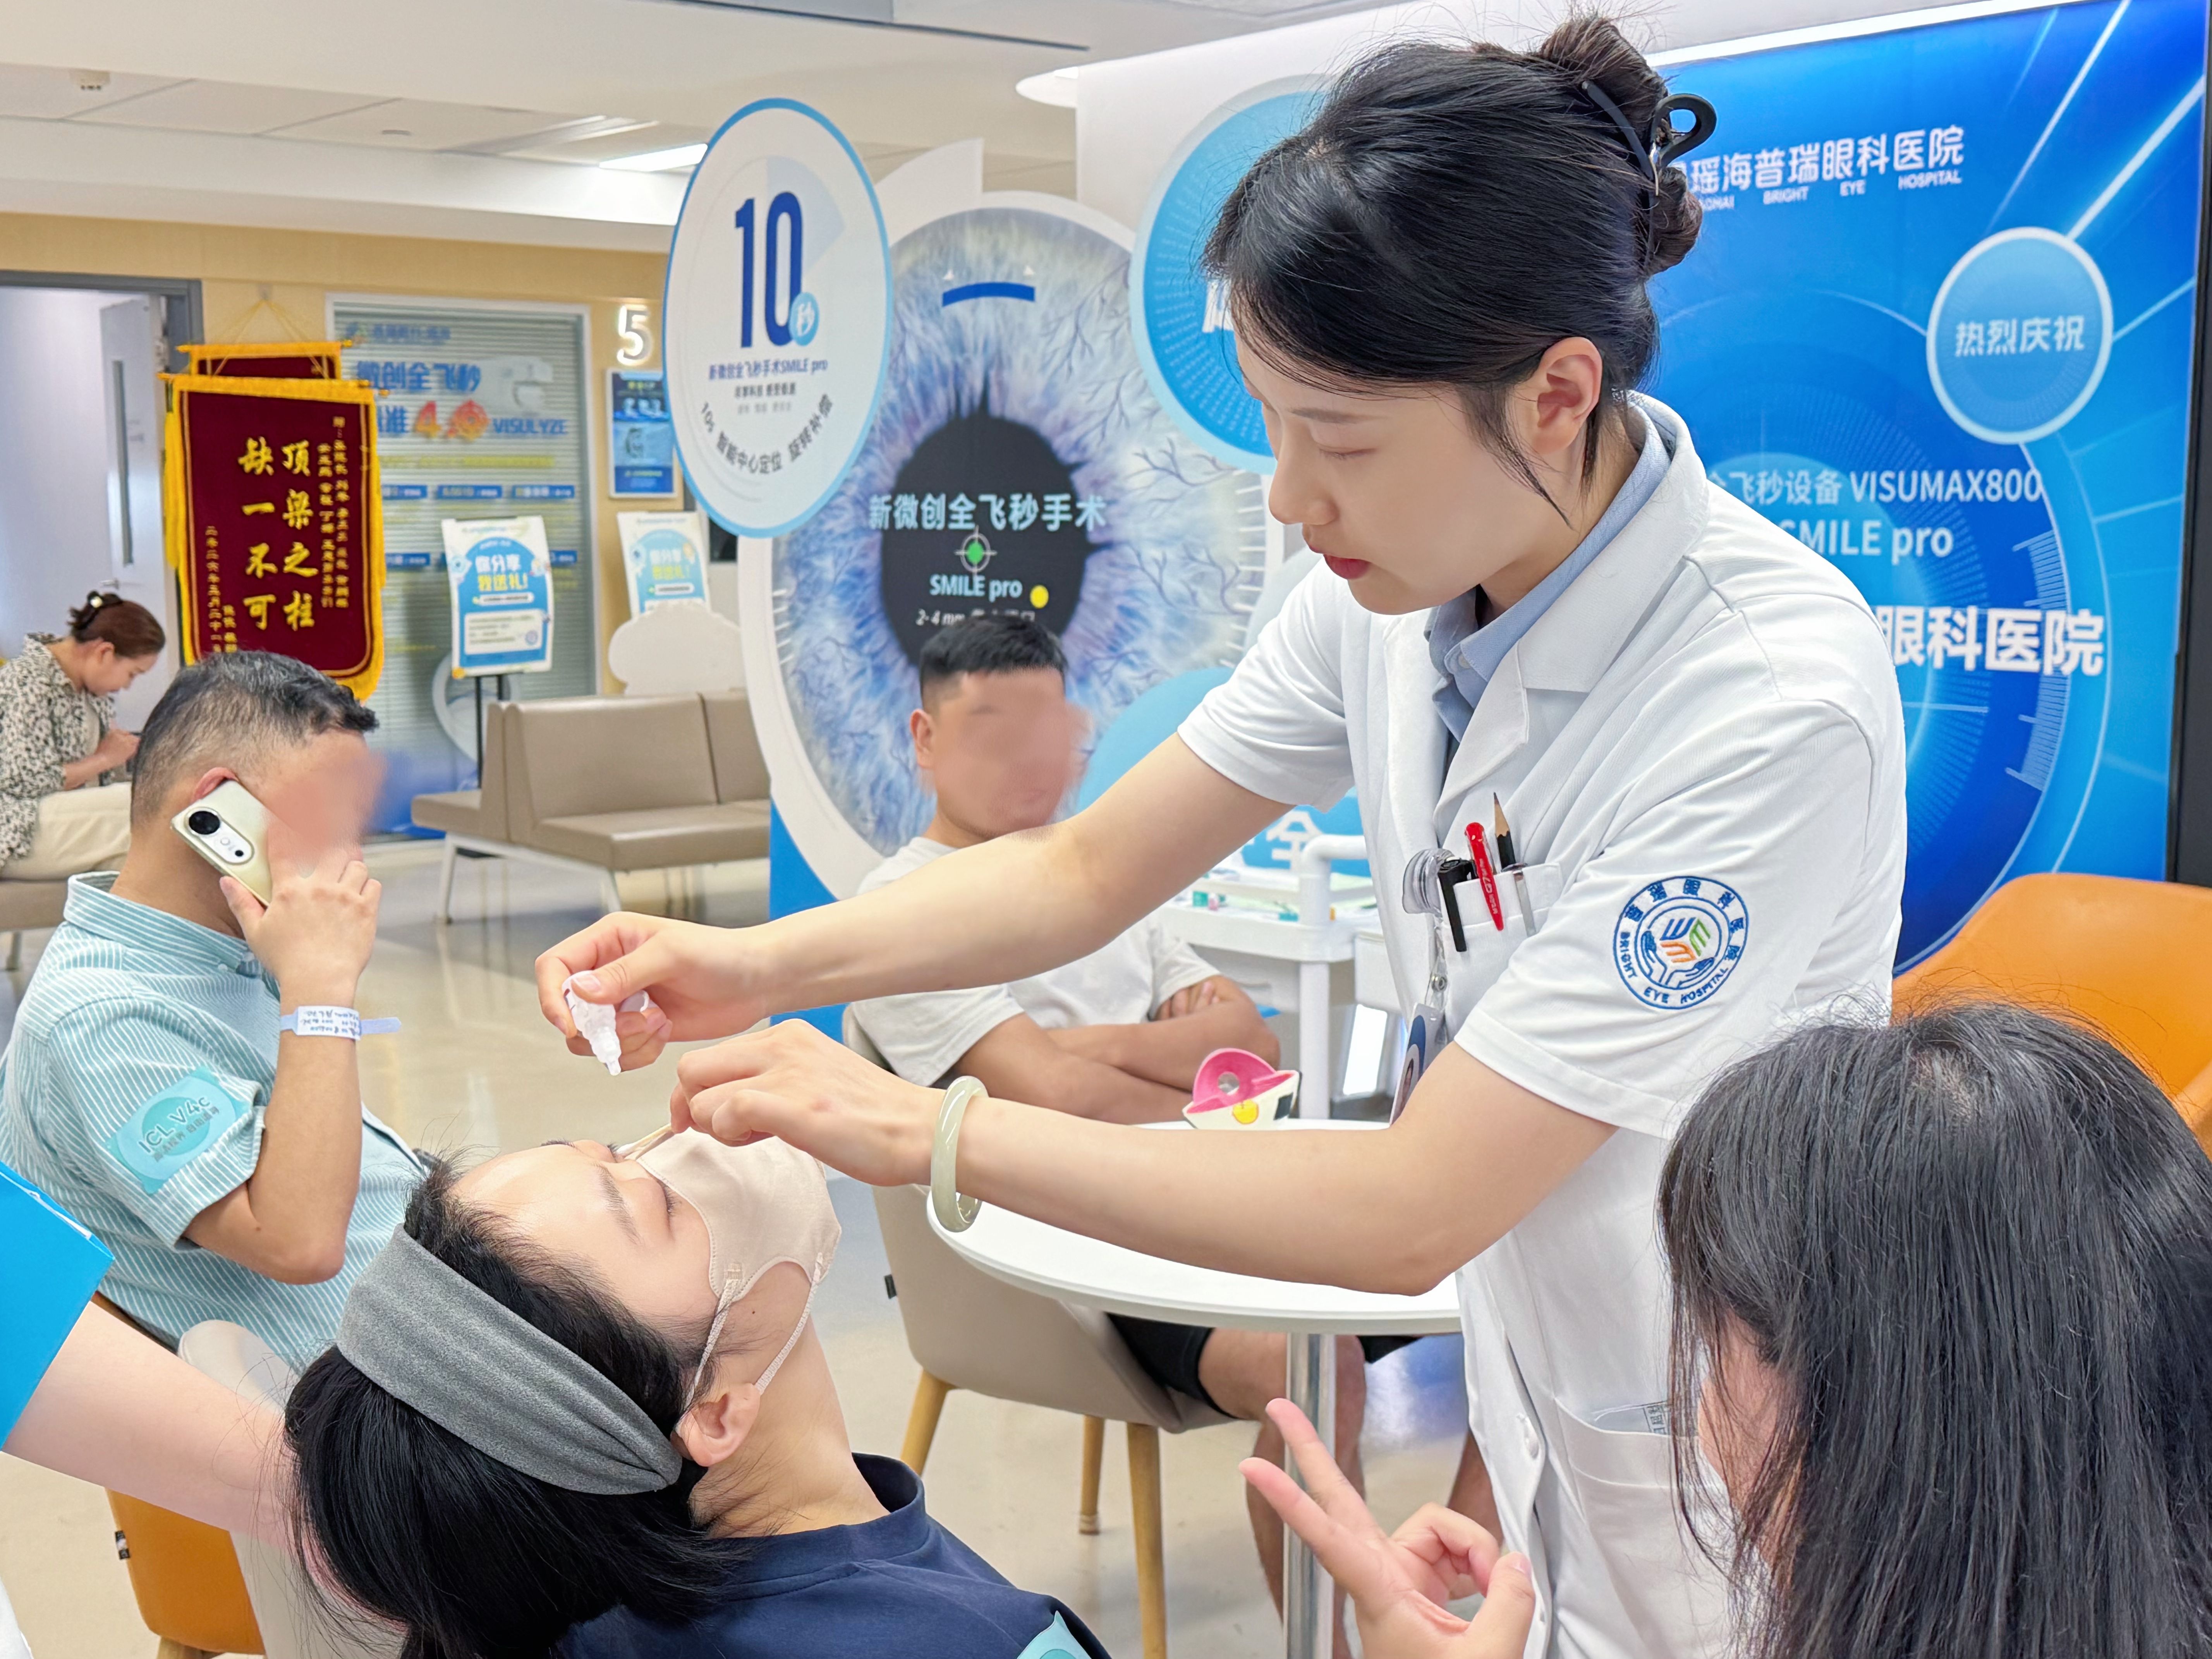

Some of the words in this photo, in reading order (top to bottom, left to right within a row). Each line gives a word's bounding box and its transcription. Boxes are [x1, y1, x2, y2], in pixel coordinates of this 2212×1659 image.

[1668, 124, 1965, 194] 瑶海普瑞眼科医院
[1763, 186, 1809, 205] BRIGHT
[1840, 179, 1866, 197] EYE
[1898, 170, 1962, 190] HOSPITAL
[735, 191, 803, 348] 10
[617, 304, 653, 366] 5
[1955, 314, 2085, 357] 热烈庆祝
[1850, 468, 2042, 503] VISUMAX800
[238, 436, 278, 630] 缺一不可
[281, 438, 319, 631] 顶梁之柱
[869, 493, 1106, 532] 新微创全飞秒手术
[1891, 525, 1954, 565] pro
[930, 574, 986, 597] SMILE
[988, 579, 1023, 603] pro
[1874, 605, 2104, 677] 眼科医院
[1620, 932, 1637, 978] BRIGHT
[1644, 986, 1670, 1004] EYE
[1680, 967, 1729, 1004] HOSPITAL
[138, 1125, 175, 1153] ICL
